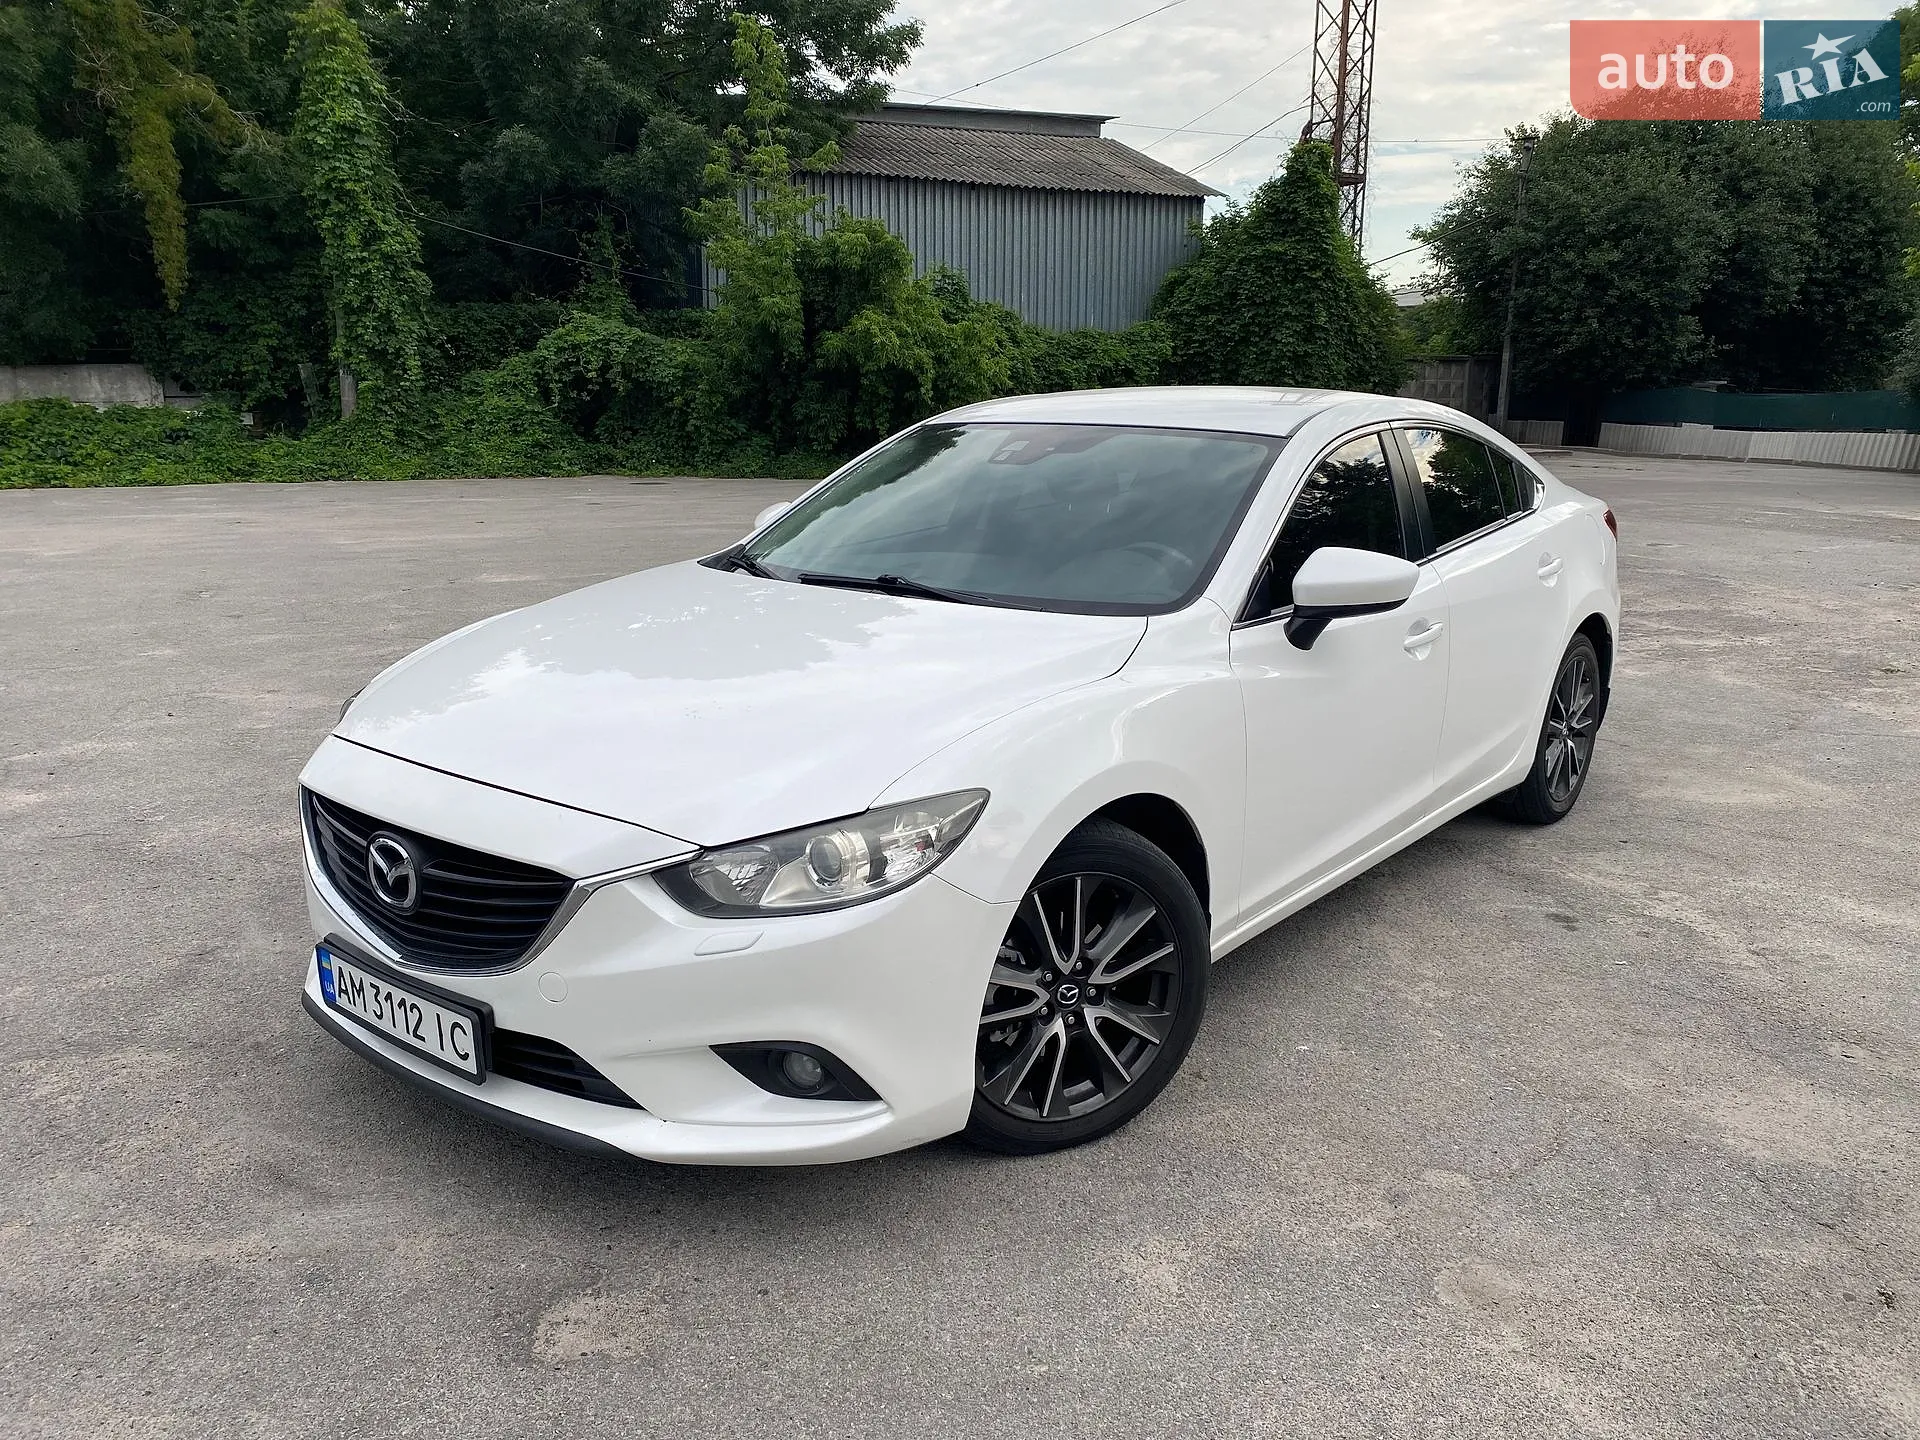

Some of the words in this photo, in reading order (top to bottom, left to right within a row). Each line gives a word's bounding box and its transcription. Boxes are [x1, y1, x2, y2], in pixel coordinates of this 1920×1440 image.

[325, 982, 335, 995] UA
[337, 965, 368, 1014] AM
[369, 981, 426, 1043] 3112
[436, 1012, 470, 1061] IC
